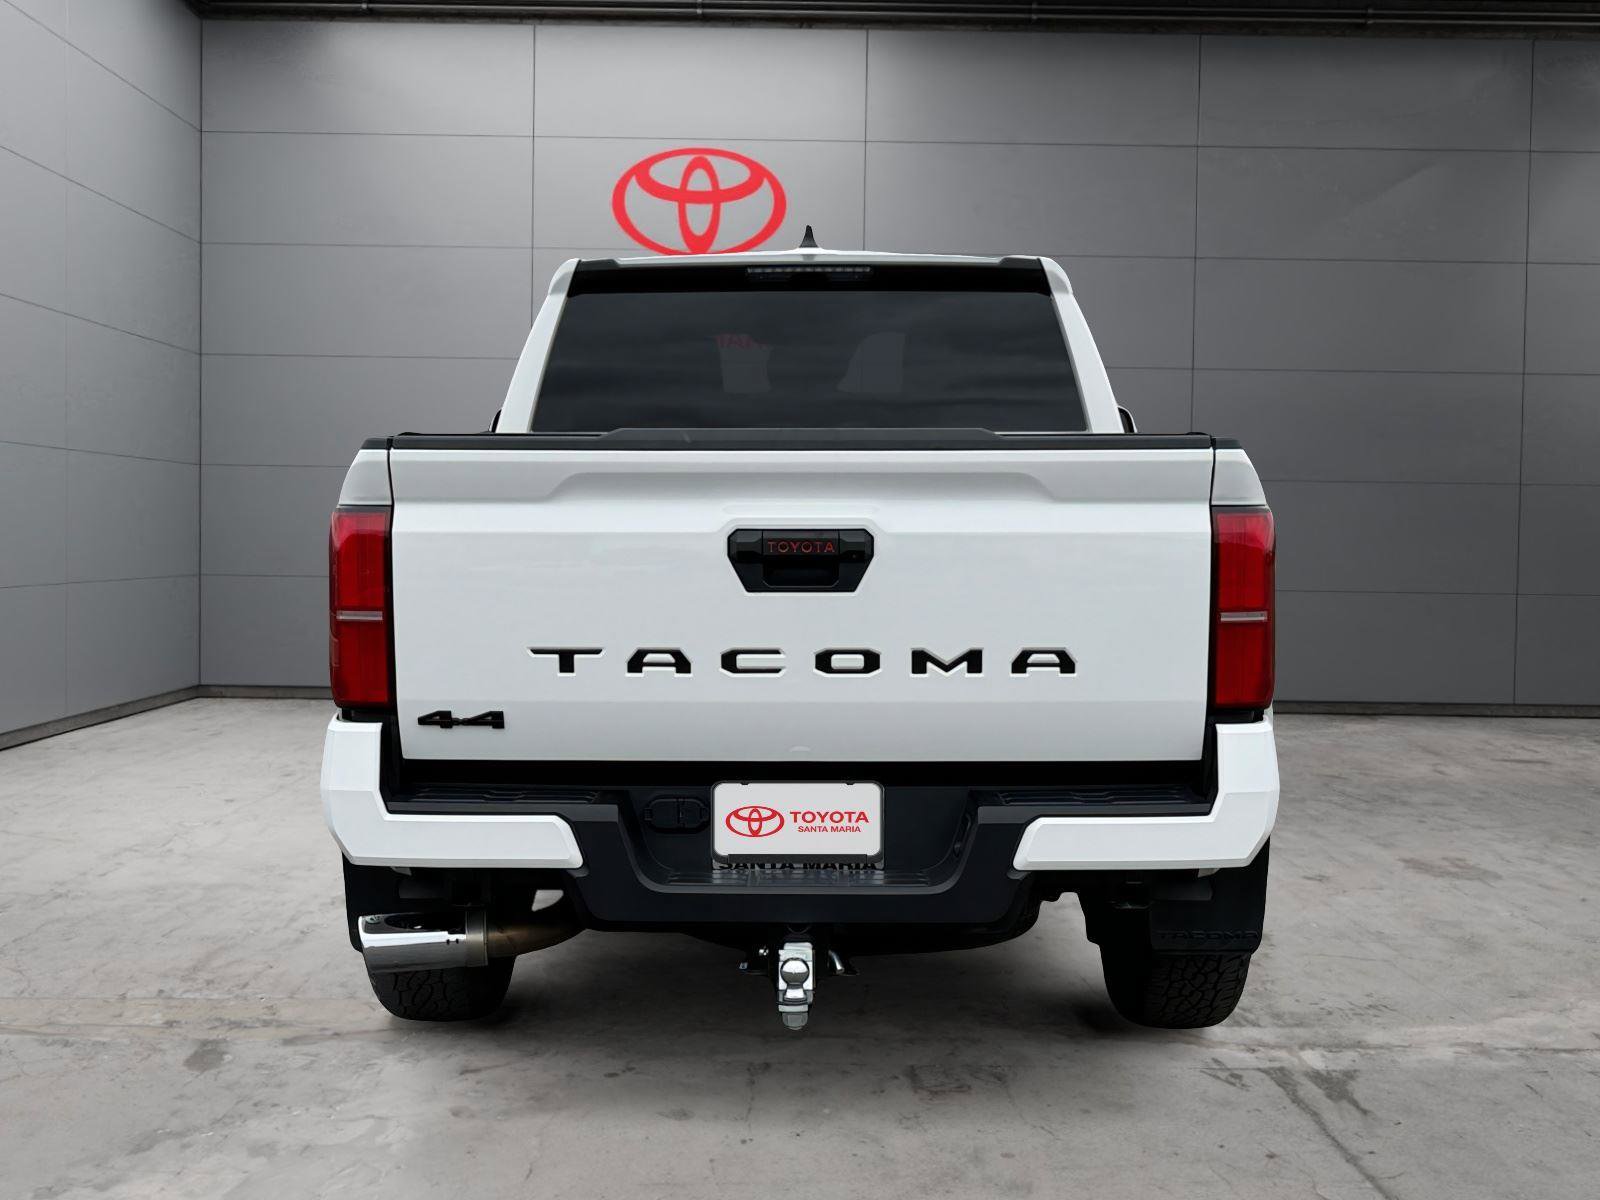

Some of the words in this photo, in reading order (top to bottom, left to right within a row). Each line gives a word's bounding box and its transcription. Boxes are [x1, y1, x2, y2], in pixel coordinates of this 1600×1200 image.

[767, 541, 835, 553] TOYOTA
[528, 646, 1077, 676] TACOMA
[790, 811, 869, 823] TOYOTA
